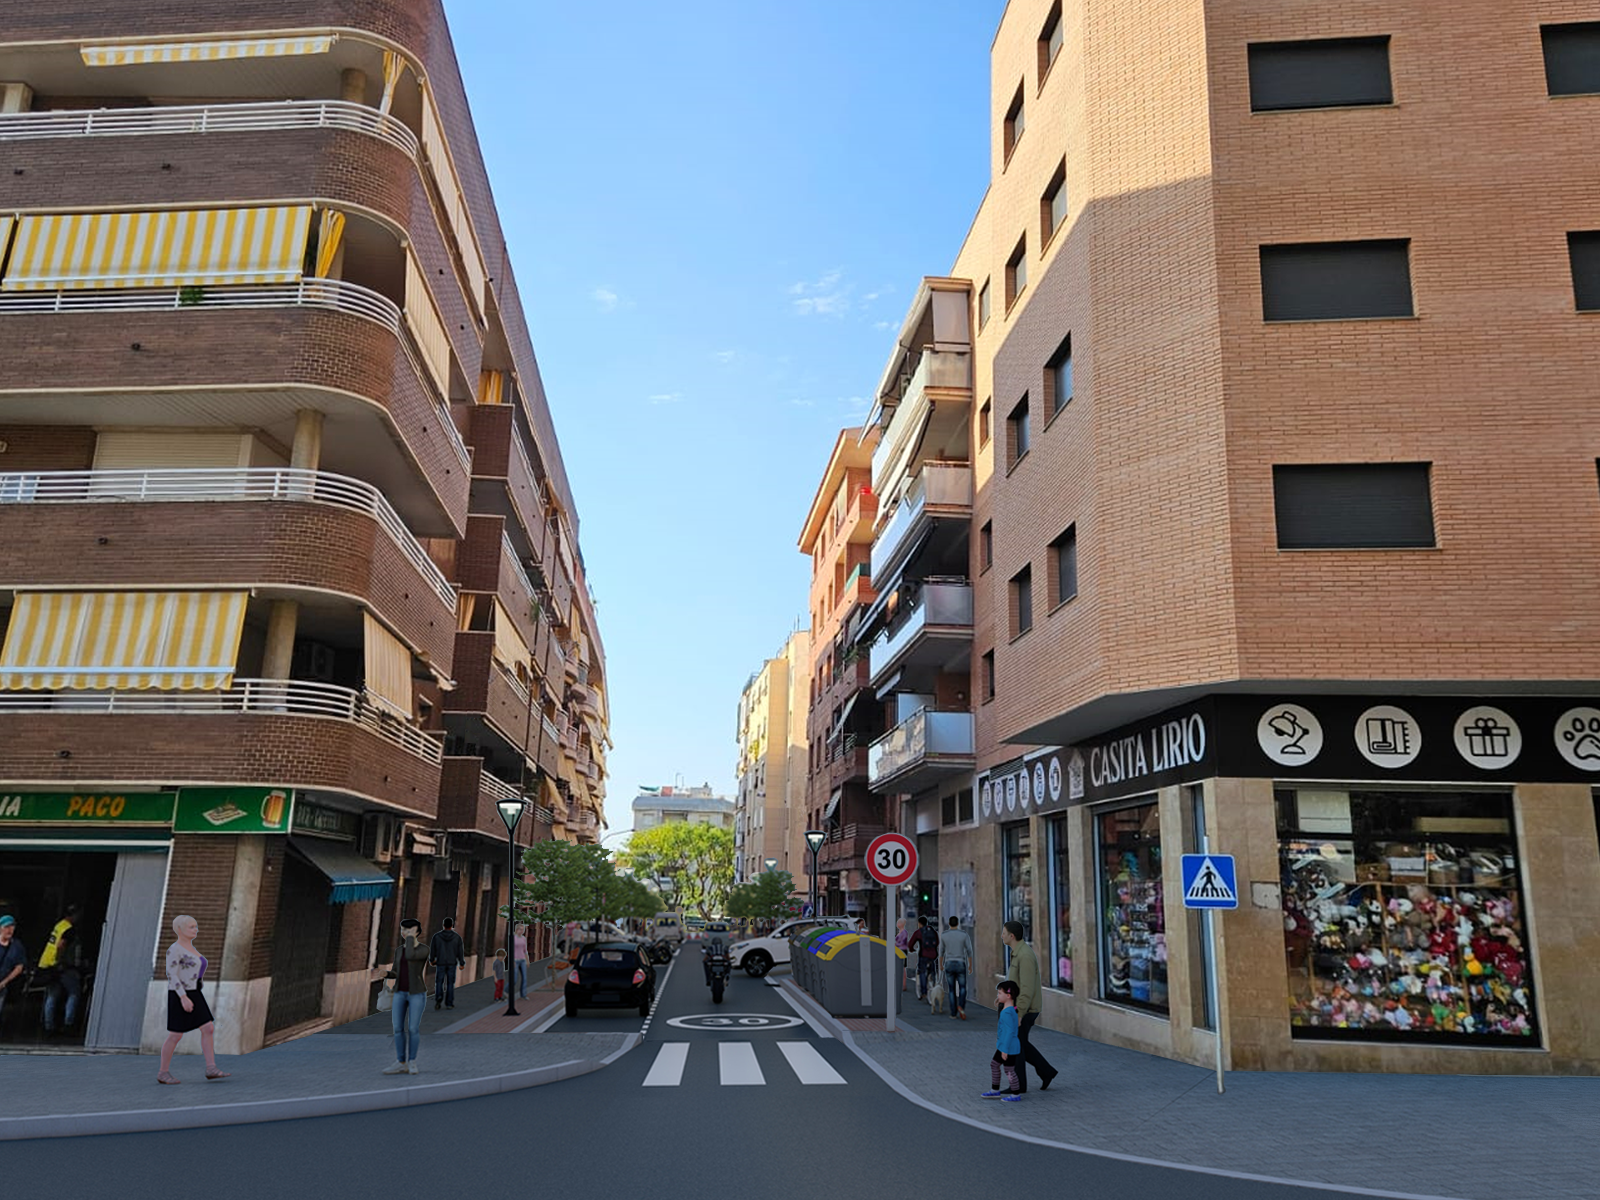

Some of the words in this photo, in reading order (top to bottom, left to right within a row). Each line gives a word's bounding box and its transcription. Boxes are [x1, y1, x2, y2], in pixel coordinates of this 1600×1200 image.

[1091, 733, 1148, 787] CASITA
[1151, 712, 1206, 772] LIRIO
[66, 796, 126, 817] PACO
[877, 849, 906, 870] 30
[701, 1017, 770, 1026] 30
